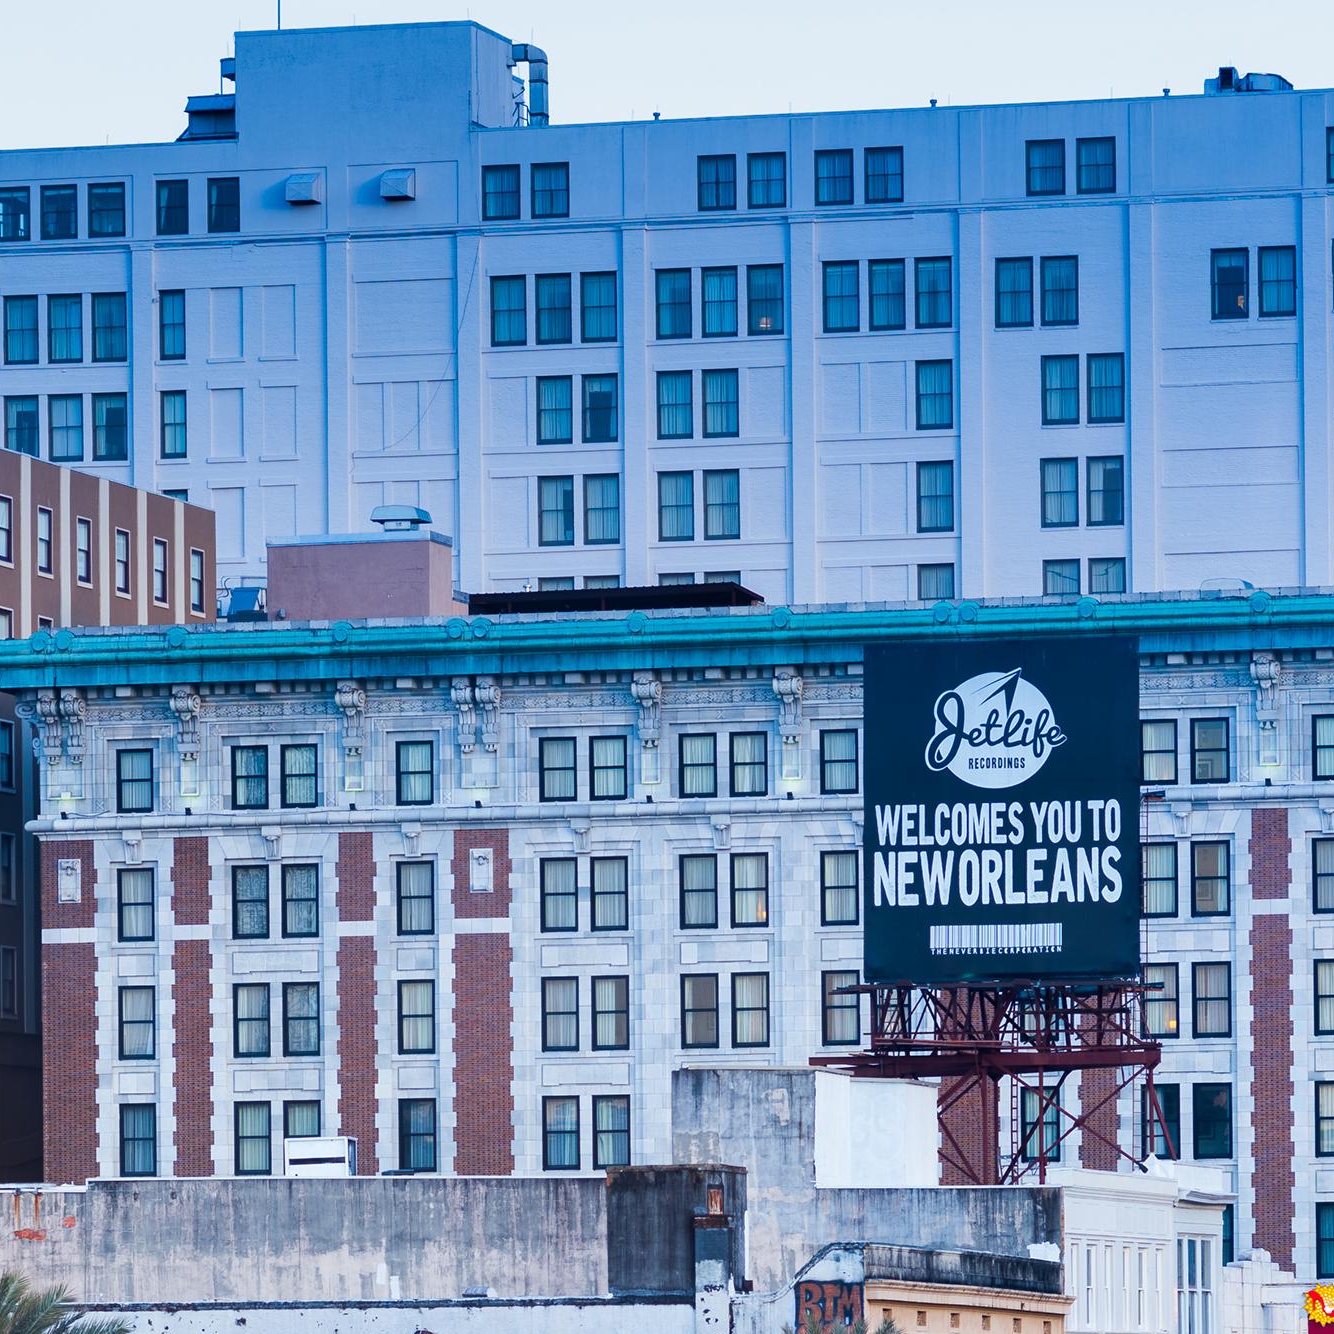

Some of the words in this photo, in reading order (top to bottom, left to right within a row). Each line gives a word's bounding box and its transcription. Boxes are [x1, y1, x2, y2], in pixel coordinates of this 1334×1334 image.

[968, 757, 1026, 770] RECORDINGS
[875, 802, 1025, 846] WELCOMES
[1030, 800, 1082, 843] YOU
[1087, 798, 1121, 842] TO
[873, 850, 955, 907] NEW
[958, 845, 1123, 906] ORLEANS
